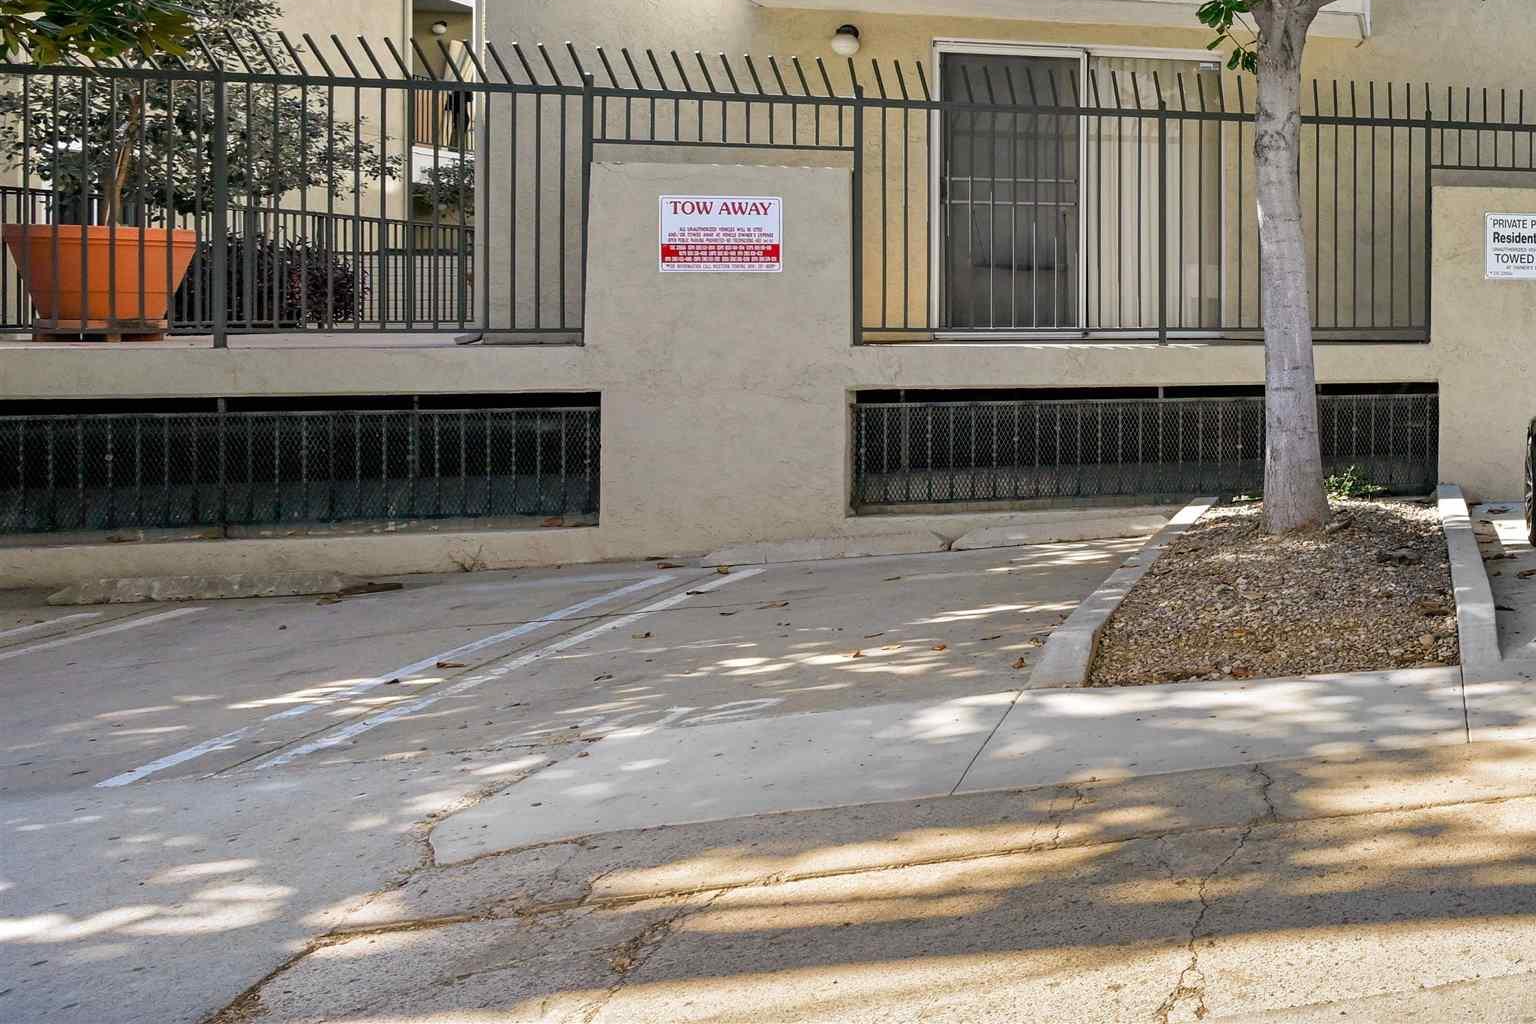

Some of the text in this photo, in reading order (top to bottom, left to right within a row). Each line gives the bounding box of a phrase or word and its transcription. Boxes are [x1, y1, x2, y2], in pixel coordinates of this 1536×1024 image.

[669, 200, 772, 216] TOW AWAY
[1492, 218, 1528, 229] PRIVATE
[1494, 253, 1535, 264] TOWED
